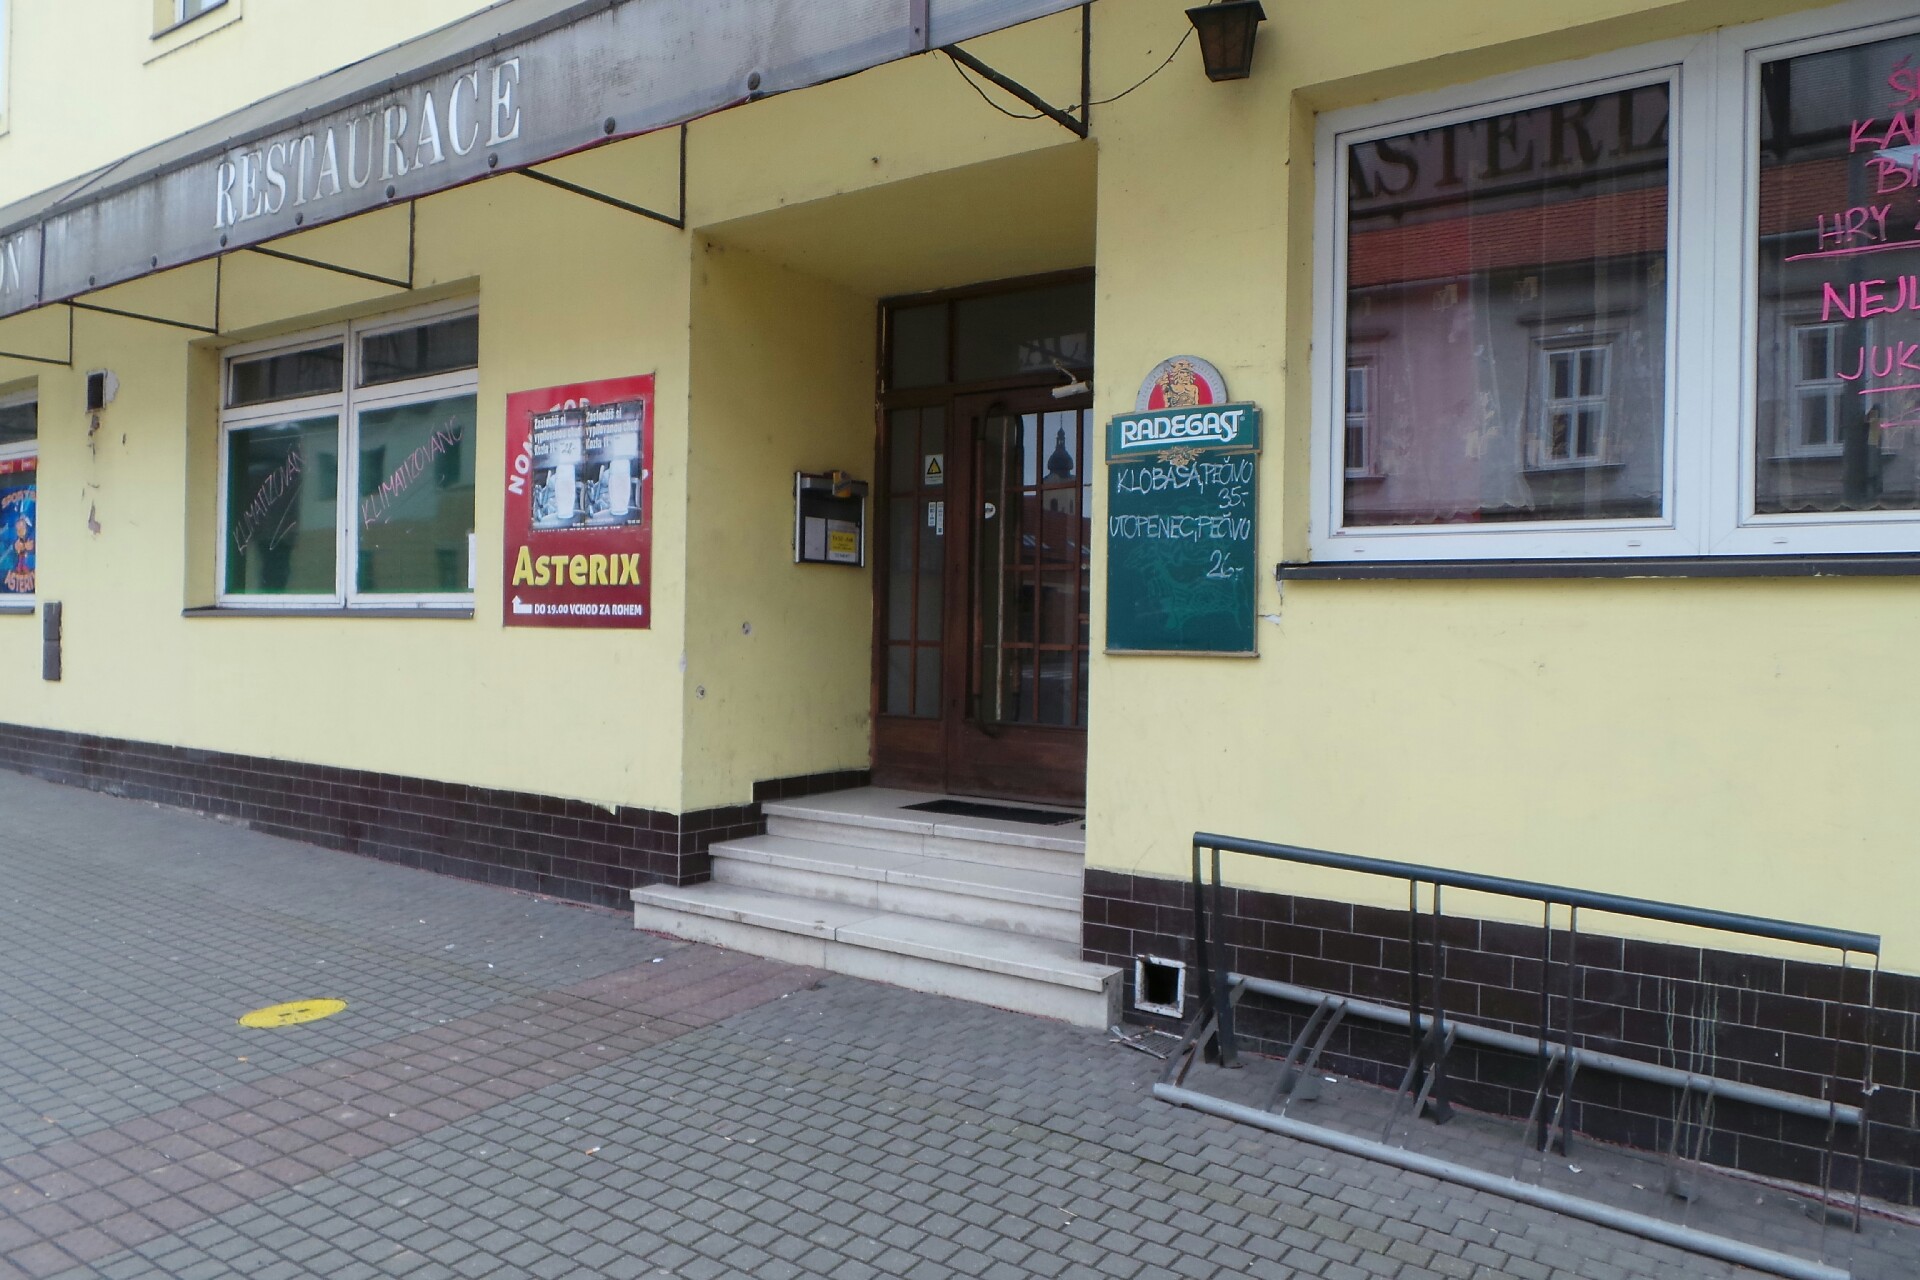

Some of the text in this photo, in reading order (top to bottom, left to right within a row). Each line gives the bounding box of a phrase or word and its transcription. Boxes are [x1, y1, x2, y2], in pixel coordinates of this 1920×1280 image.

[1888, 53, 1920, 109] Š
[213, 57, 520, 229] RESTAURACE
[1349, 85, 1669, 200] STERI
[1850, 108, 1920, 153] KA
[1818, 203, 1891, 250] HRY
[0, 236, 23, 295] N
[1121, 409, 1243, 449] RADEGAST
[534, 603, 642, 616] DO 19.00 VCHOD ZA ROHEM
